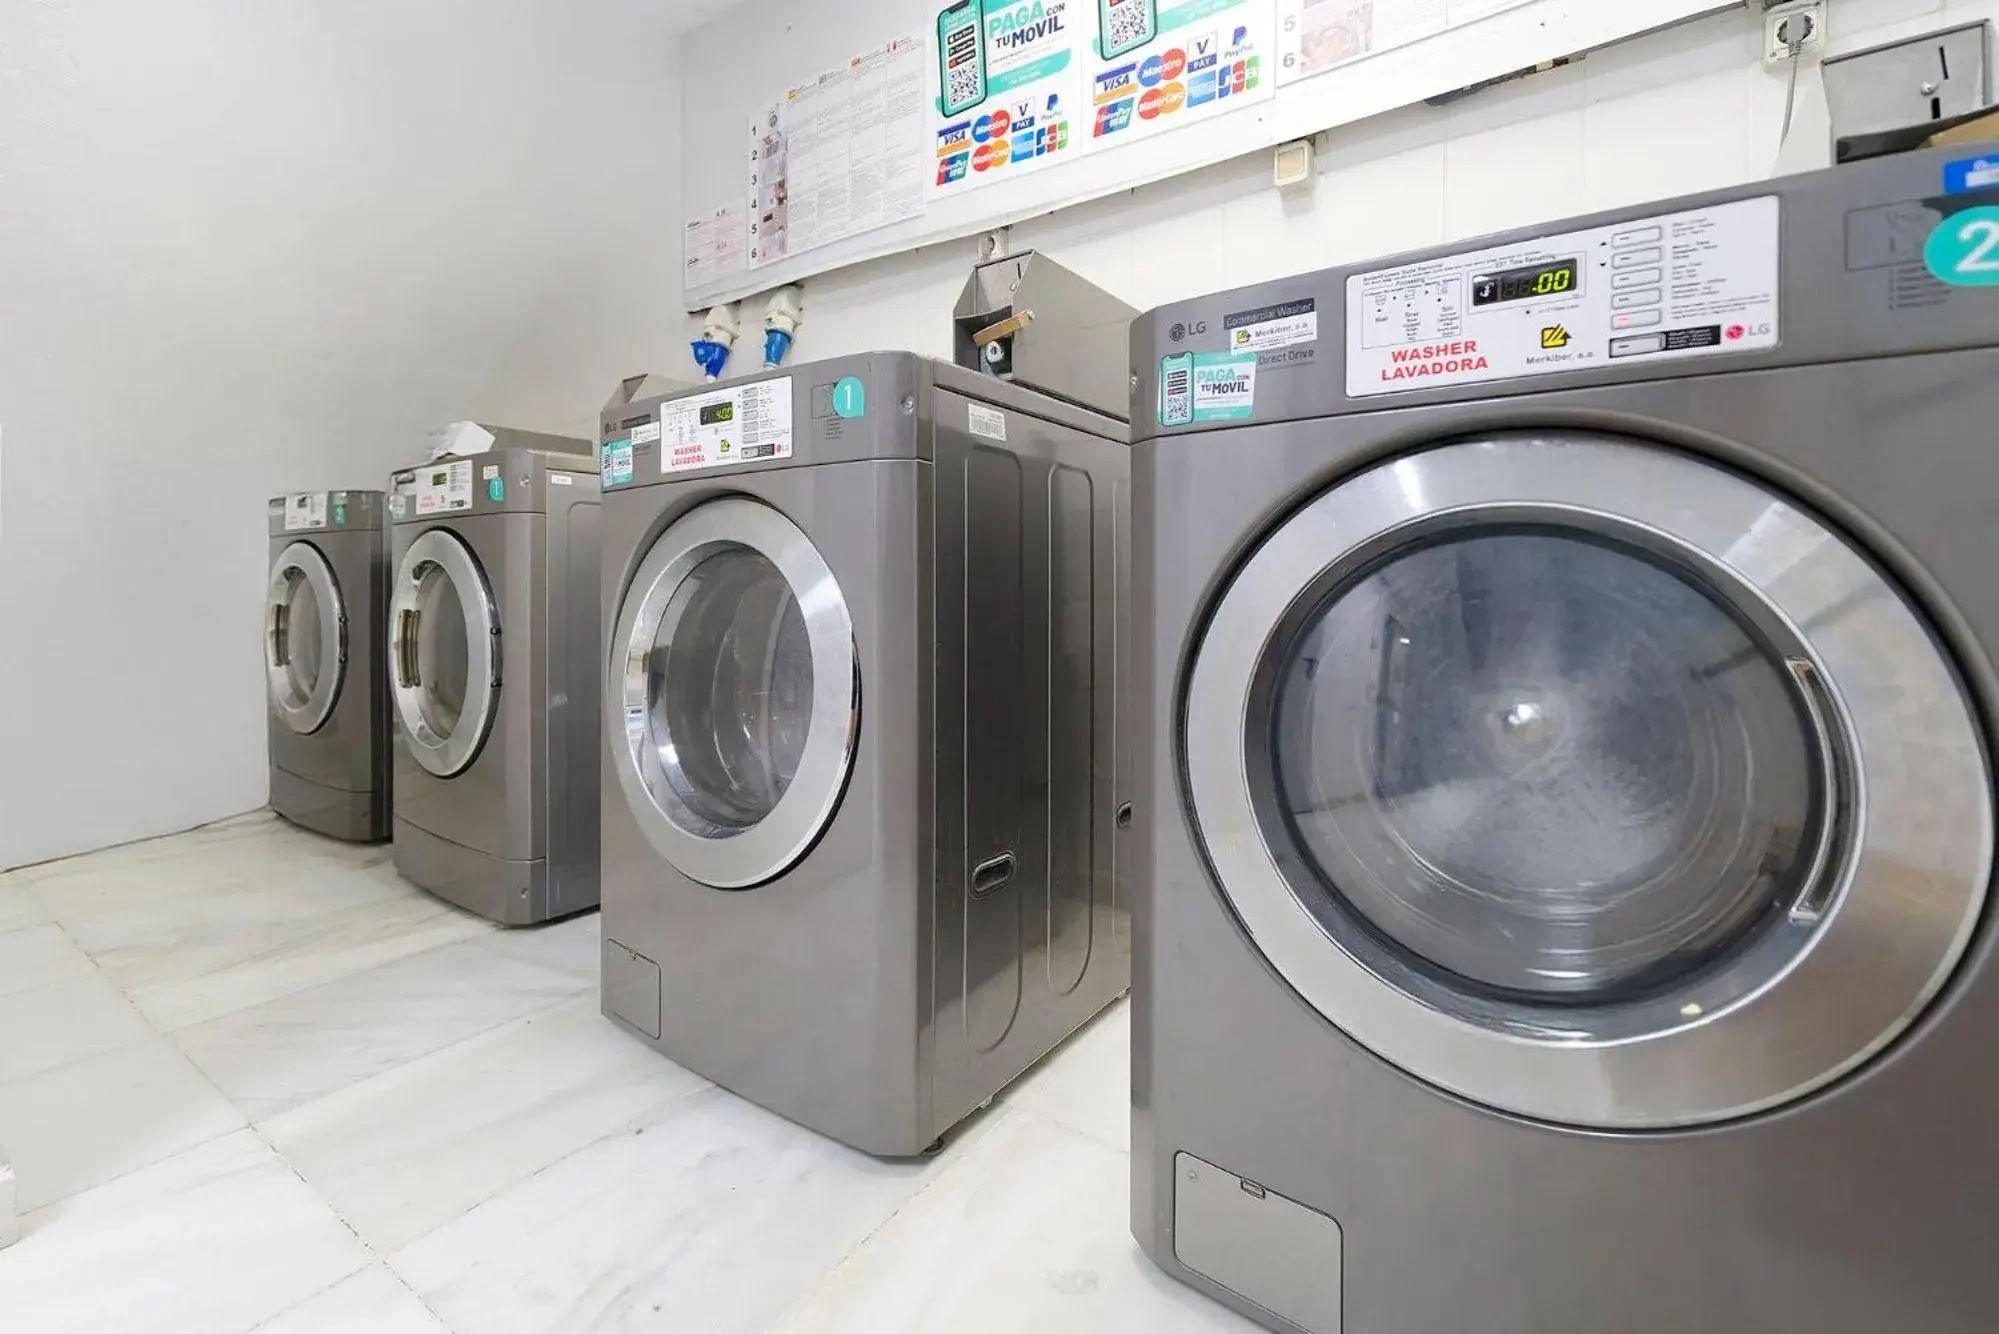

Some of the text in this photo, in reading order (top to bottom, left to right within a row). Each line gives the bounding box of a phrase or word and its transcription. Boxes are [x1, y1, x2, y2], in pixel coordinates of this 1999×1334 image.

[989, 1, 1046, 39] PAGA
[1046, 2, 1066, 17] CON
[1284, 15, 1295, 31] 5
[995, 34, 1012, 49] TU
[1011, 15, 1064, 48] MOVIL
[1141, 58, 1183, 79] Maestro
[1193, 56, 1212, 69] PAY
[1283, 53, 1295, 68] 6
[1101, 73, 1131, 92] VISA
[751, 124, 758, 136] 1
[943, 130, 967, 146] VISA
[751, 149, 758, 161] 2
[751, 173, 758, 186] 3
[751, 223, 758, 235] 5
[751, 247, 758, 259] 6
[1955, 220, 1999, 272] 2
[1277, 302, 1312, 318] Washer
[1188, 320, 1207, 336] LG
[1748, 323, 1770, 337] LG
[1258, 348, 1315, 366] Direct Drive
[1391, 340, 1477, 363] WASHER
[1197, 368, 1236, 383] PAGA
[1381, 355, 1488, 382] LAVADORA
[1212, 381, 1249, 394] MOVIL
[843, 384, 852, 410] 1
